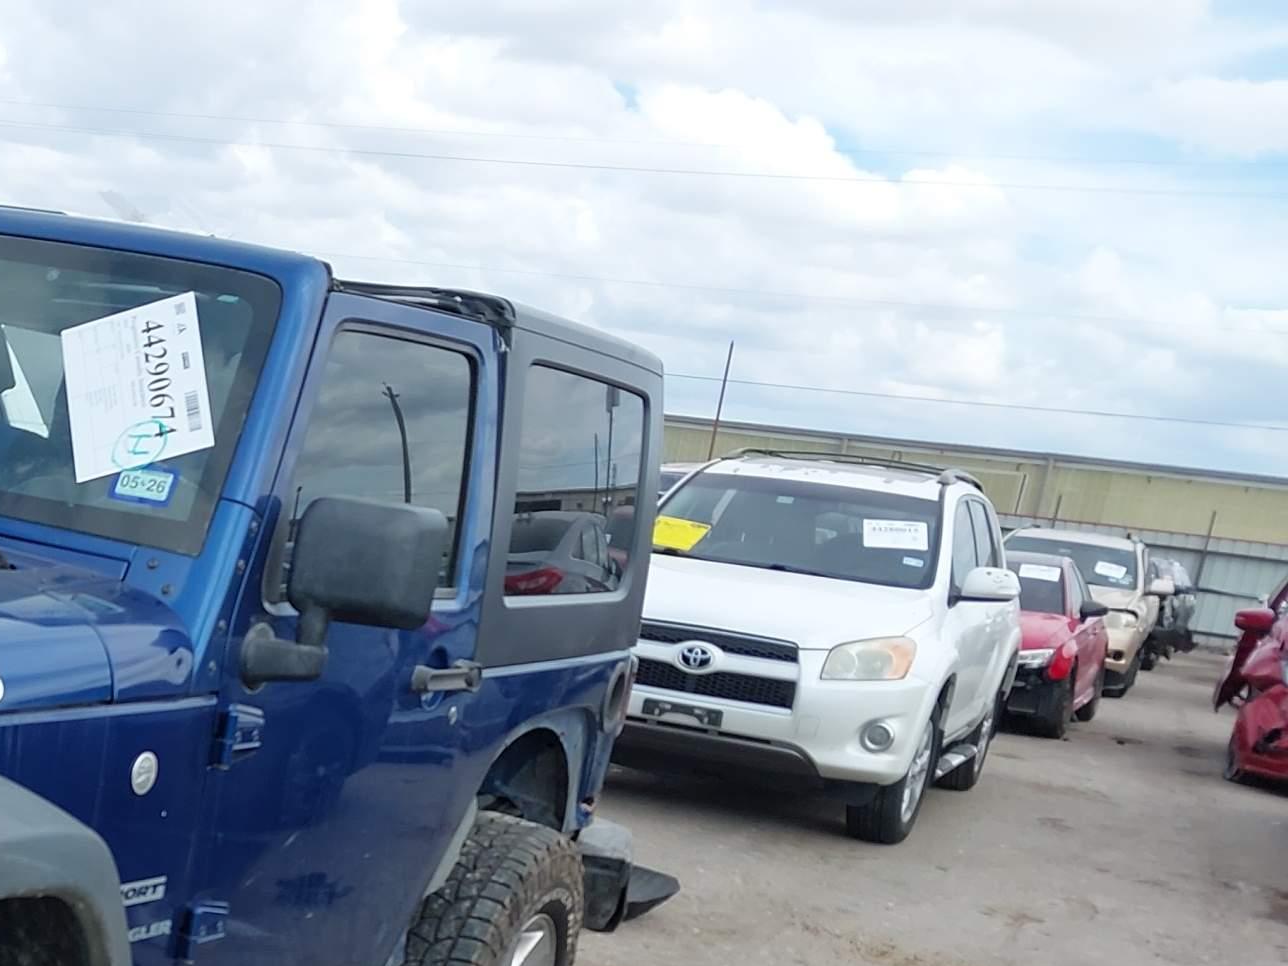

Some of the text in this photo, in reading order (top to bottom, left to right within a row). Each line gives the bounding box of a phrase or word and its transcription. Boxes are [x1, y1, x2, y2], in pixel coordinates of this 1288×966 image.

[141, 320, 177, 438] 44290674
[120, 883, 167, 900] ORT
[127, 919, 172, 942] GLER
